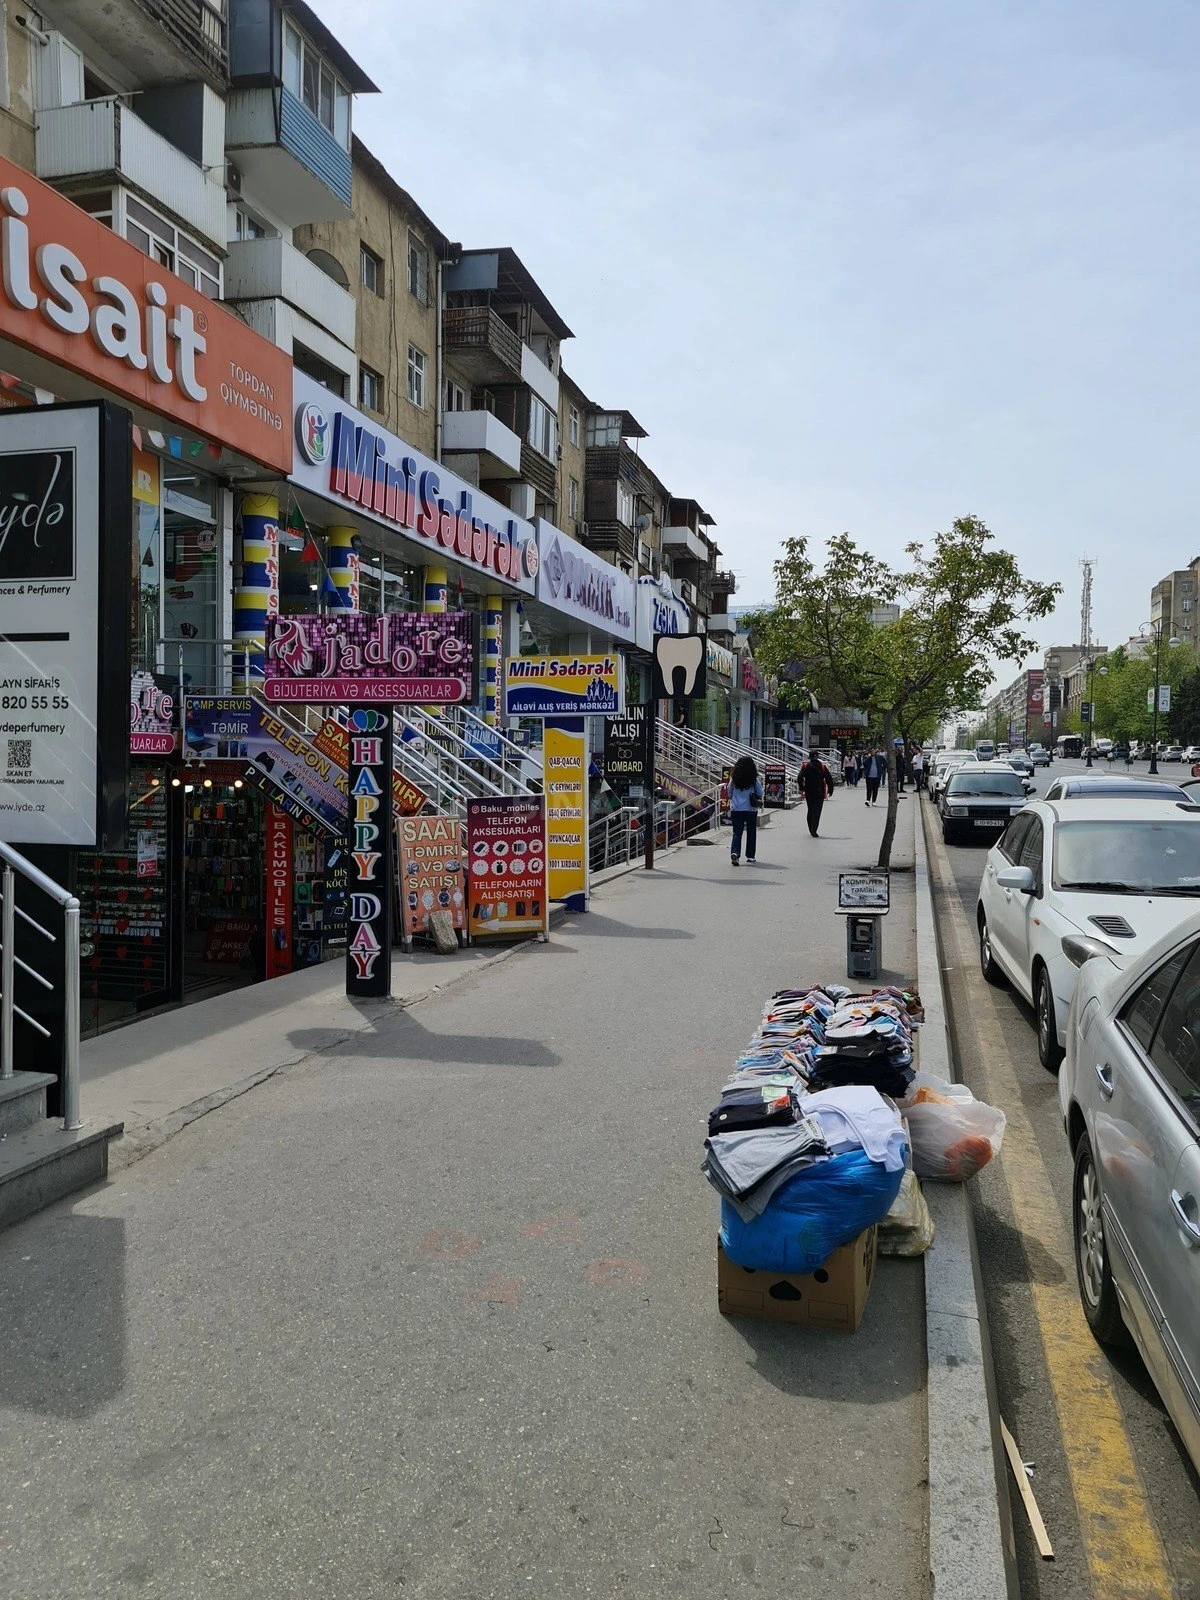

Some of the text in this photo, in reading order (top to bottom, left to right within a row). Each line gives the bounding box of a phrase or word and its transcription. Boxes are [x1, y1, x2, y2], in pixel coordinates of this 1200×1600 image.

[229, 360, 275, 402] TOPDAN
[220, 382, 283, 431] QİYMƏTİNƏ
[329, 411, 524, 582] Mini Sədərək
[18, 585, 25, 594] &
[27, 584, 71, 596] Perfumery
[508, 658, 615, 677] Mini Sədərək
[24, 676, 60, 691] SİFARİŞ
[273, 681, 452, 698] BİJUTERİYA VƏ AKSESSUARLAR
[31, 696, 48, 709] 55
[52, 696, 69, 709] 55
[216, 699, 252, 710] SERVİS
[511, 700, 615, 713] AİLƏVİ ALIŞ VERİŞ MƏRKƏZİ
[211, 720, 249, 734] TƏMİR
[610, 723, 640, 741] ALIŞI
[549, 757, 581, 768] QAB-QACAQ
[607, 761, 643, 773] LOMBARD
[480, 804, 540, 814] Baku_mobiles
[486, 816, 527, 826] TELEFON
[403, 818, 460, 842] SAAT
[472, 826, 541, 836] AKSESUARLARI
[404, 842, 459, 858] TƏMİRİ
[349, 736, 384, 980] HAPPY DAY
[421, 861, 444, 872] VƏ
[409, 874, 458, 889] SATIŞI
[473, 879, 542, 890] TELEFONLARIN
[481, 889, 535, 900] ALIŞI-SATIŞI
